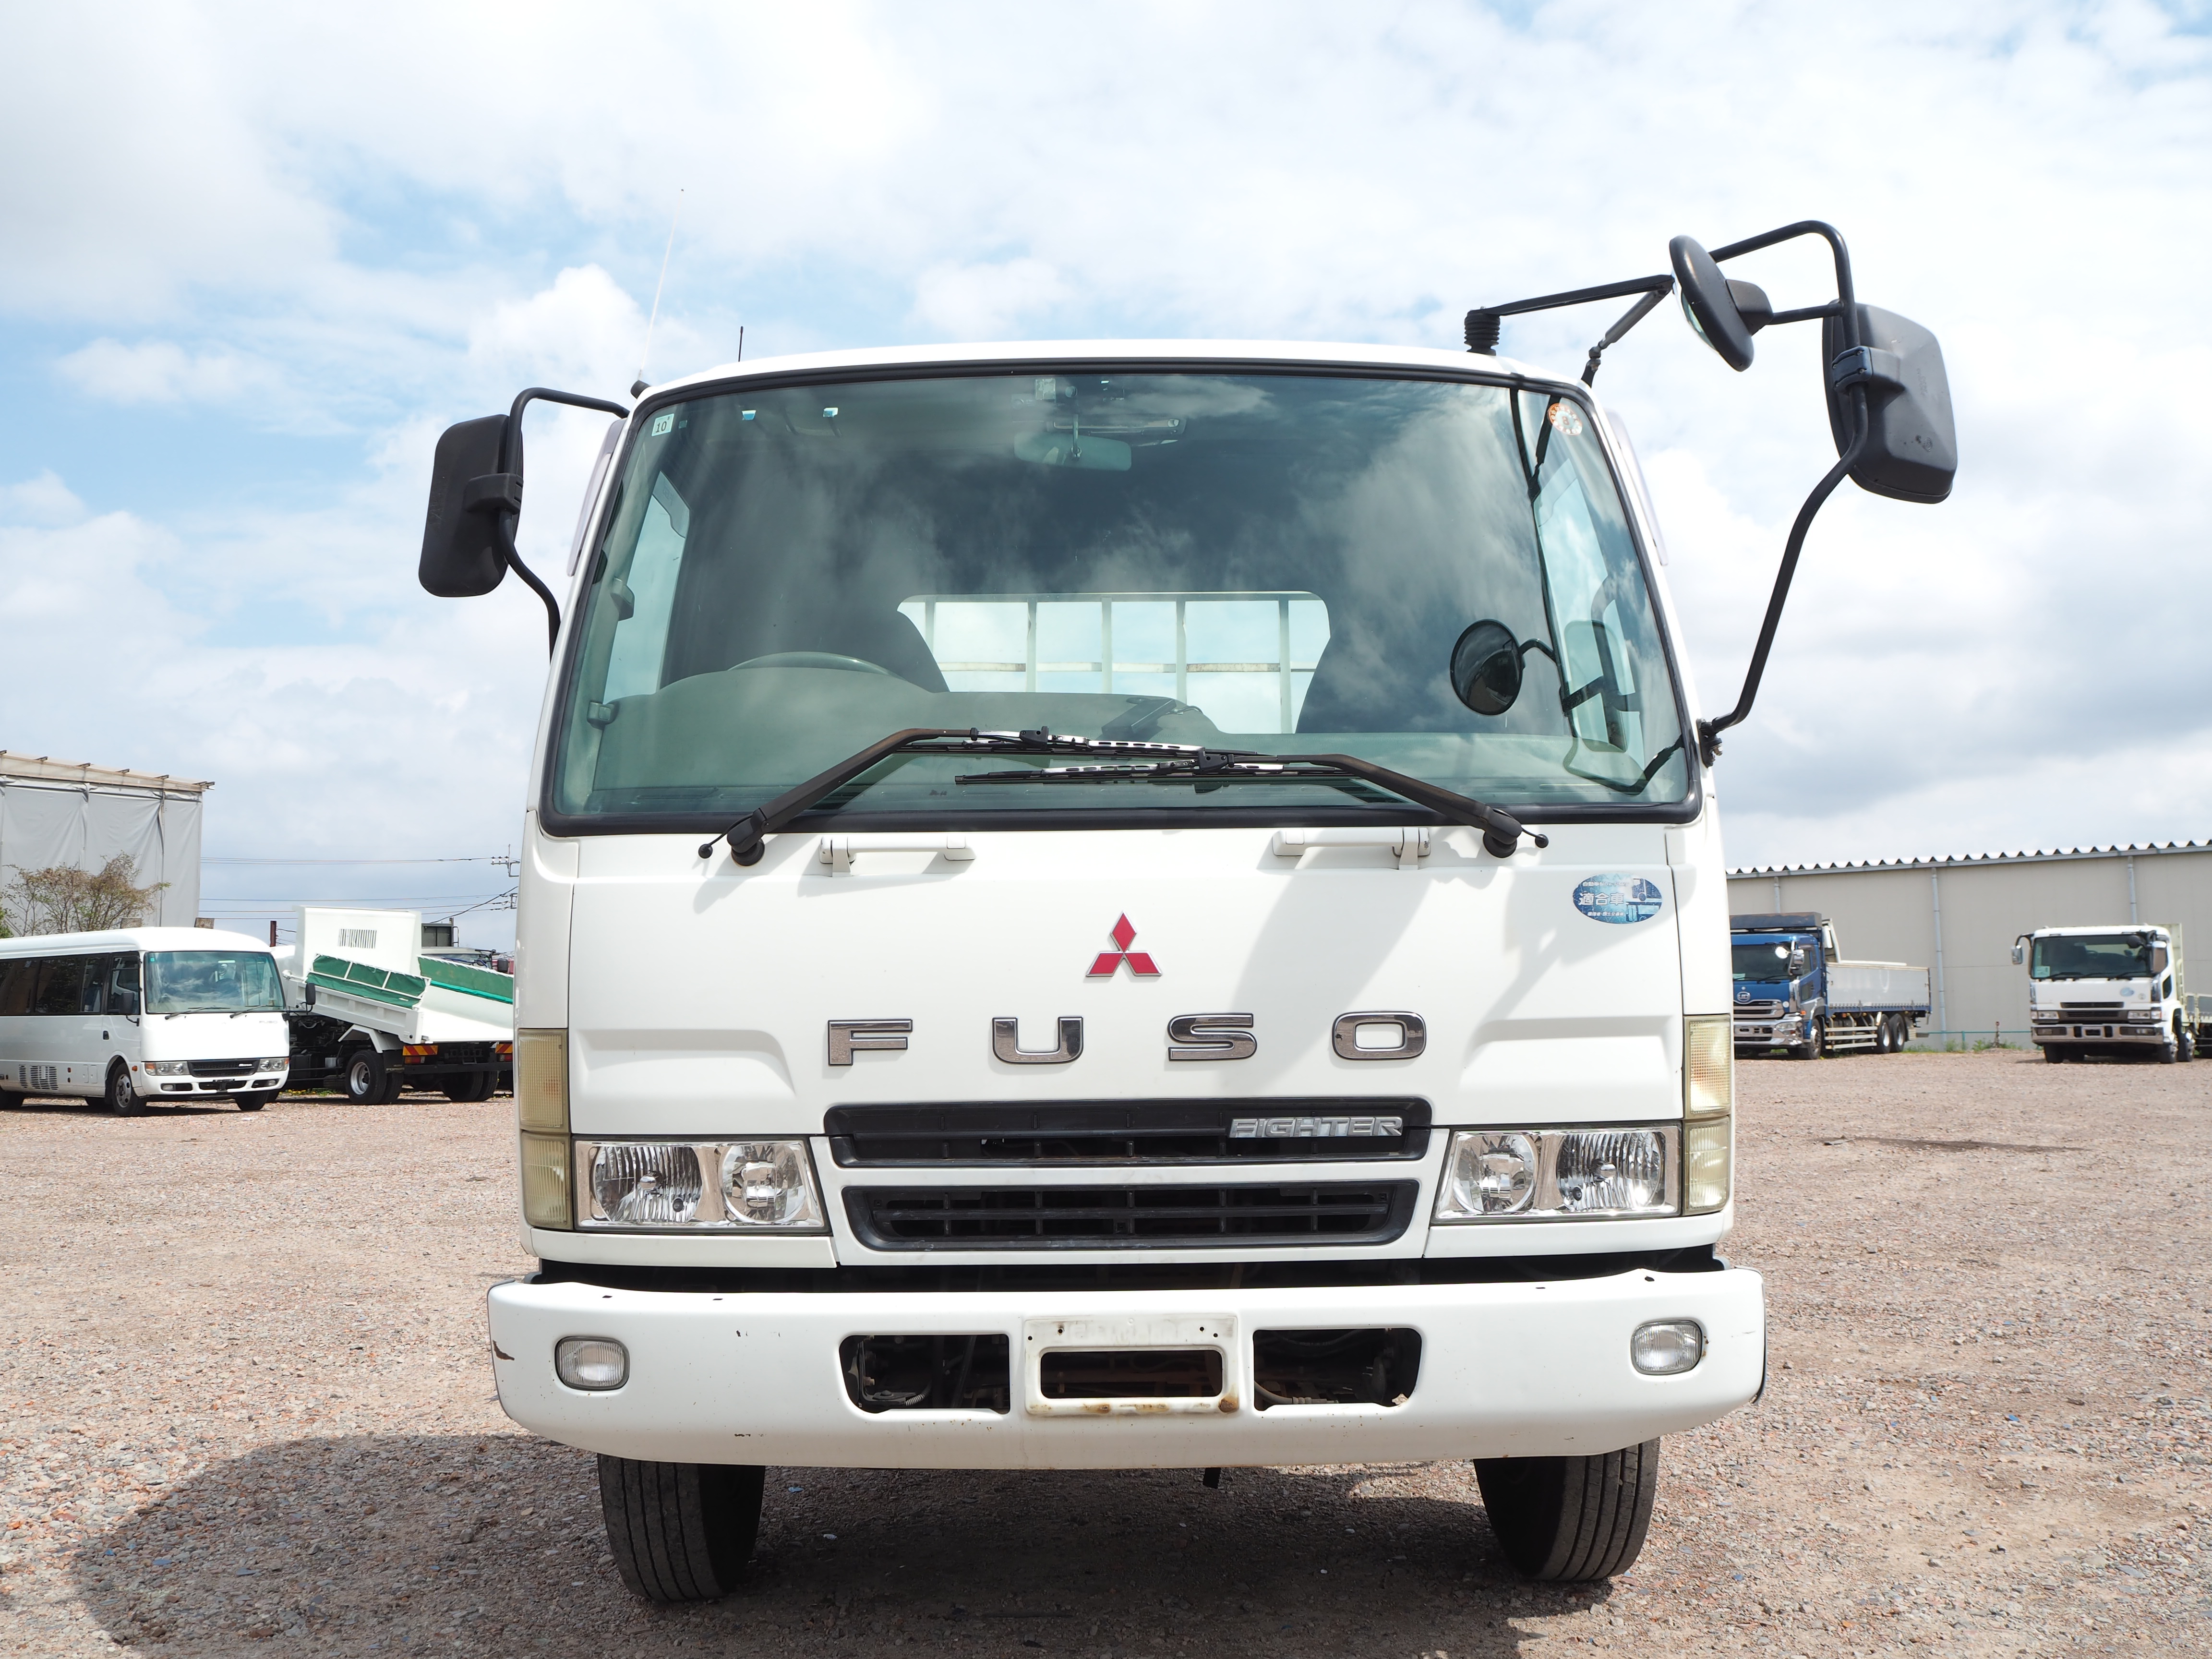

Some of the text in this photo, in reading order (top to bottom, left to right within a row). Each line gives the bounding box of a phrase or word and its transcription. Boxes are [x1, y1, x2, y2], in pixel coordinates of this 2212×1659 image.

[655, 421, 667, 433] 10
[1578, 892, 1624, 905] 適合車
[828, 1010, 1427, 1066] FUSO
[1229, 1116, 1403, 1139] FIGHTER
